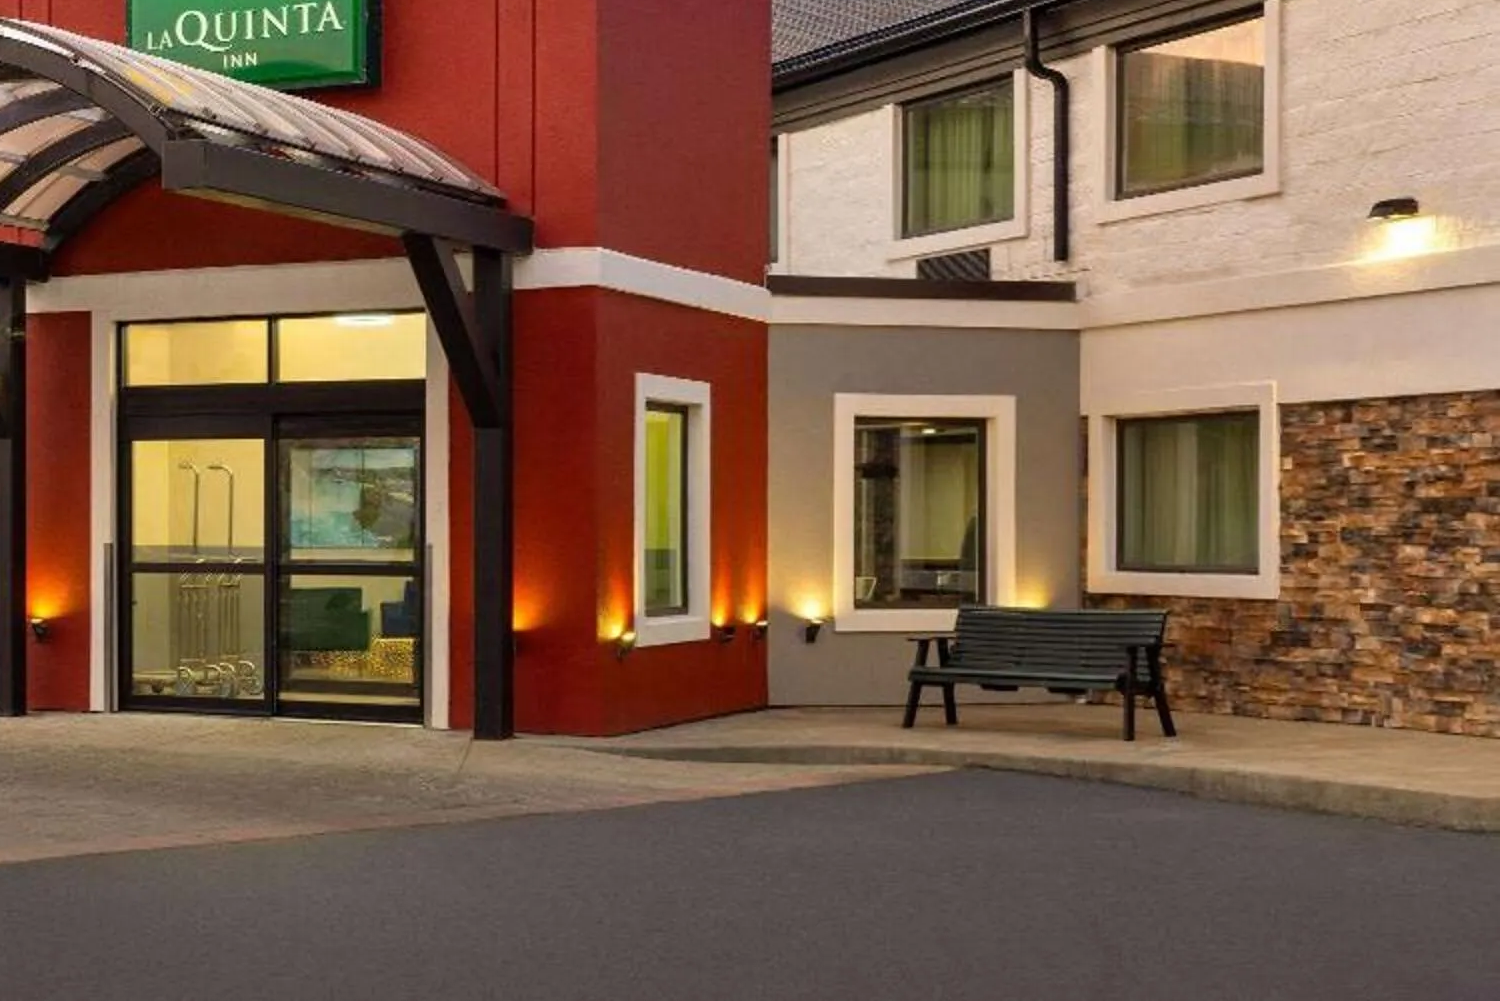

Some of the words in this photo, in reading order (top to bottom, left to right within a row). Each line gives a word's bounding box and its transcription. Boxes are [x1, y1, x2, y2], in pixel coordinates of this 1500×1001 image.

[147, 30, 173, 51] LA
[175, 1, 343, 52] QUINTA
[223, 52, 257, 68] INN
